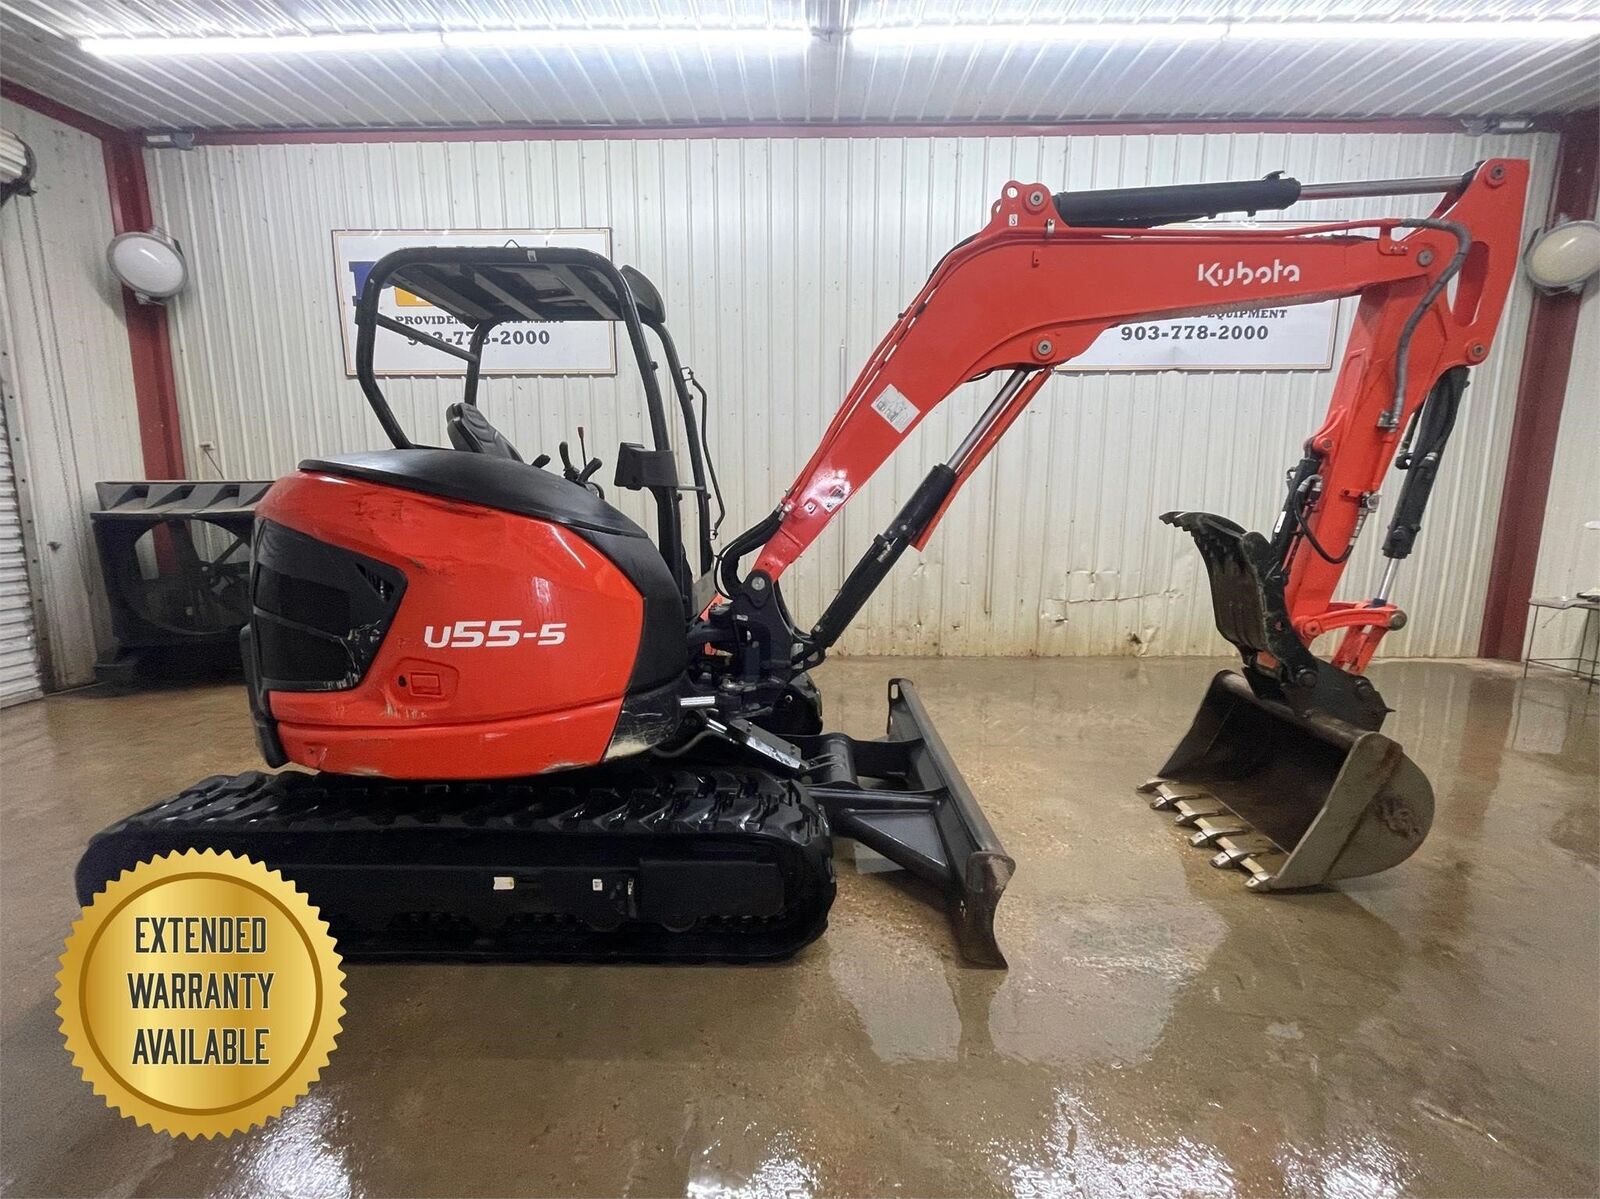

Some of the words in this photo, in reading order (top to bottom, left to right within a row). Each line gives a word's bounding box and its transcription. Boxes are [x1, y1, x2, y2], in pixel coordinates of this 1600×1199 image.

[1198, 259, 1300, 287] Kubota
[407, 330, 550, 346] 93-77-2000
[1121, 325, 1269, 341] 903-778-2000
[424, 620, 567, 648] U55-5
